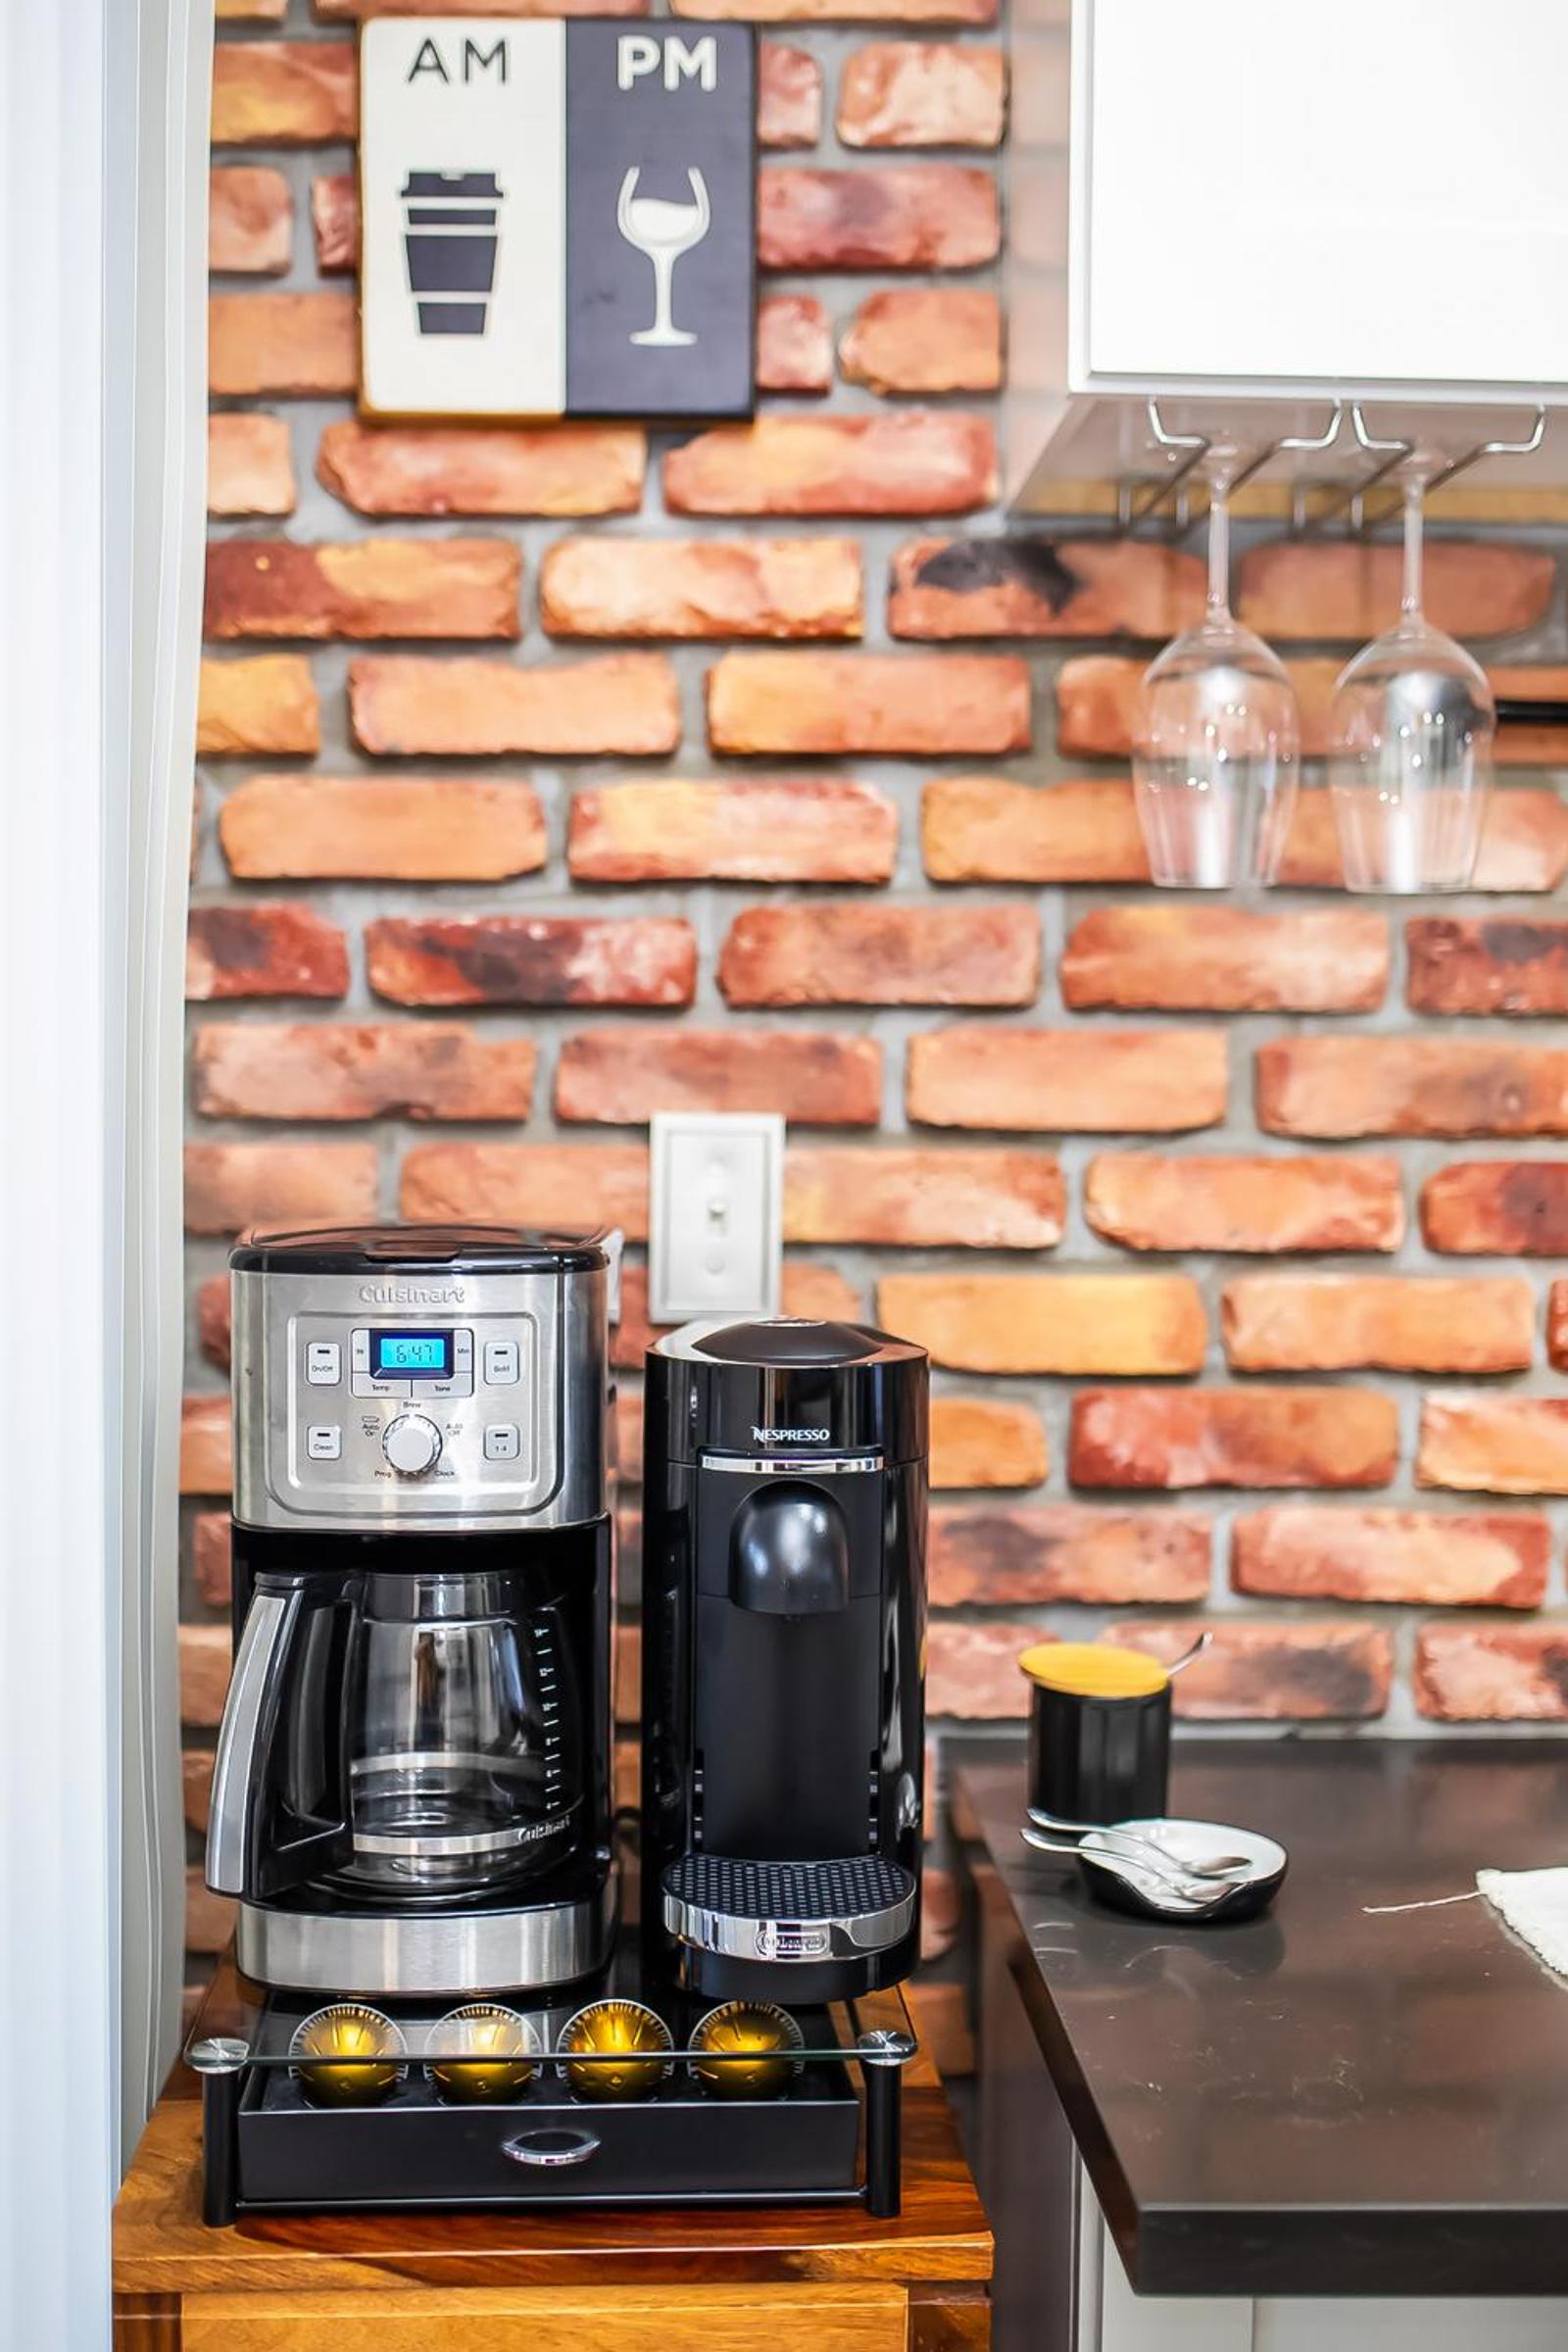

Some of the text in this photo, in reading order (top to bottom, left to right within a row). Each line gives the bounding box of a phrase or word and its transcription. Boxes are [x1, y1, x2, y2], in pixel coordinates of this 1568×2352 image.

[408, 37, 508, 85] AM
[616, 35, 718, 92] PM
[359, 1285, 466, 1304] Cuisinart
[750, 1426, 831, 1444] NESPRESSO
